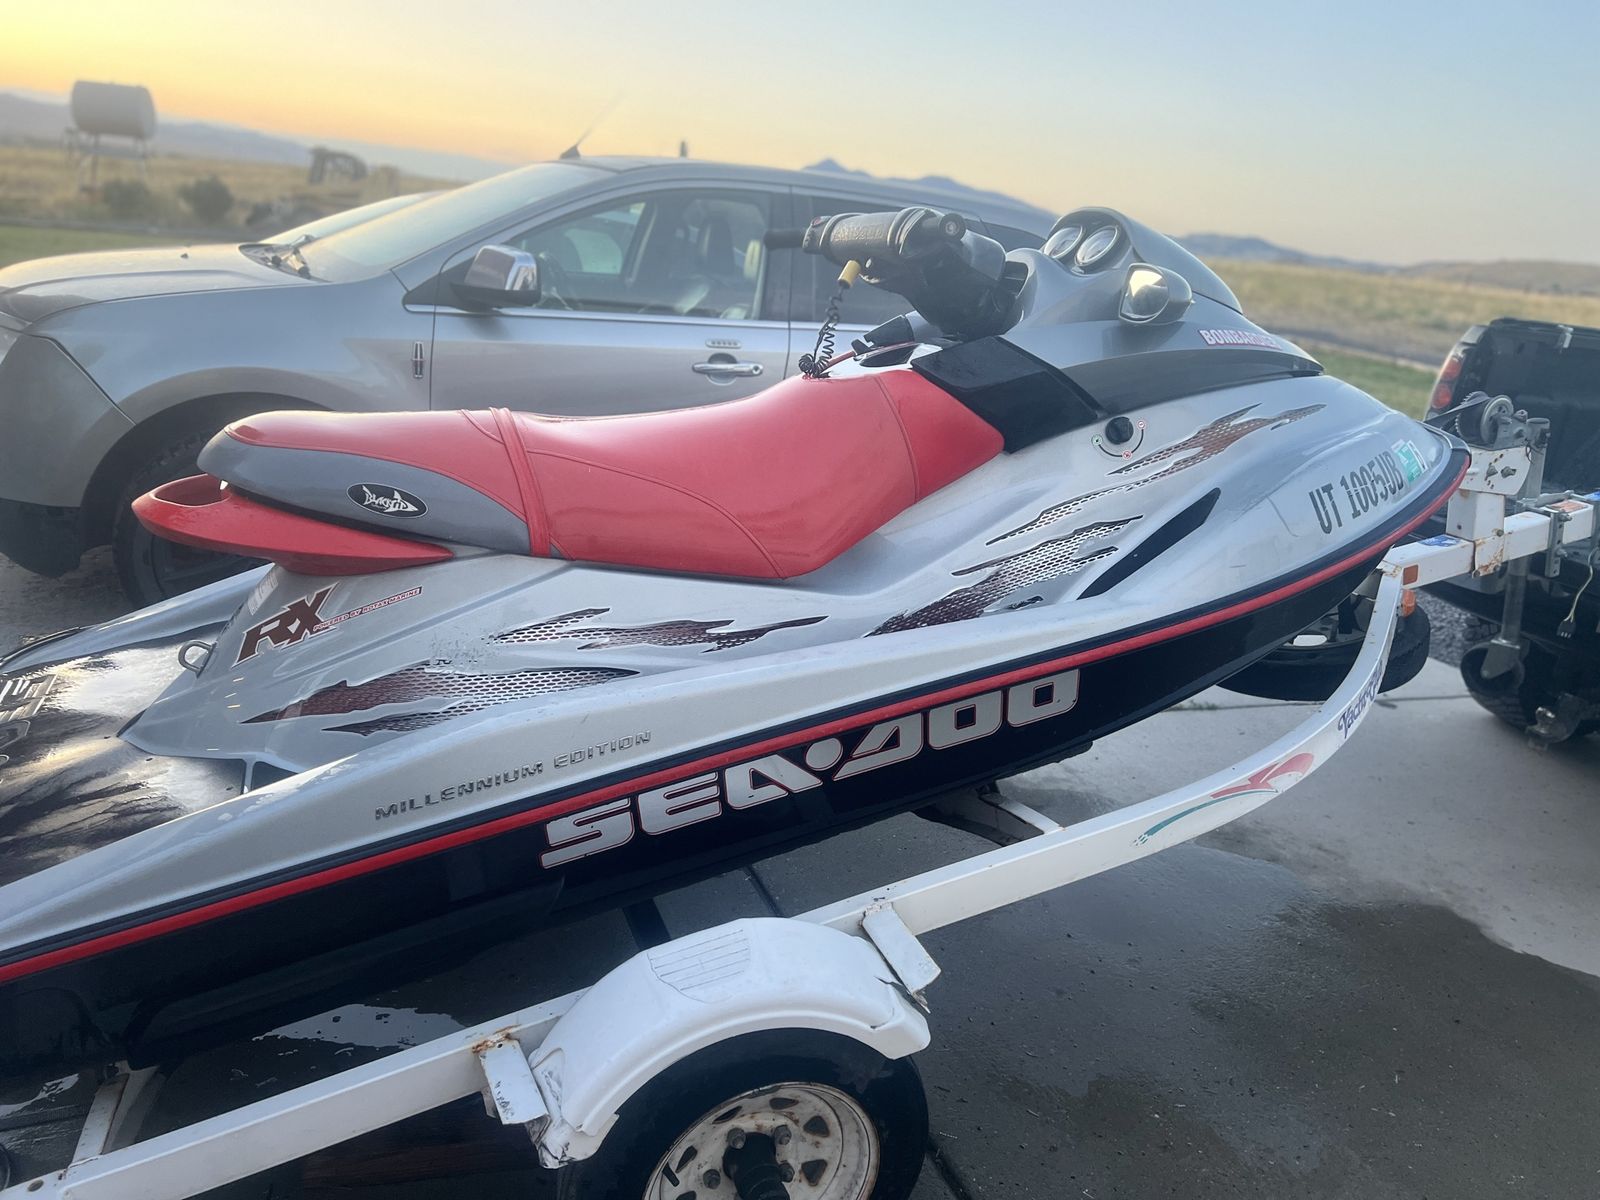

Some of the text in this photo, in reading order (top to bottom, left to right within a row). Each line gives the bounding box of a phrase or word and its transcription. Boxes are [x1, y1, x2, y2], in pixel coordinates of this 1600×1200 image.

[1309, 483, 1343, 534] UT
[1340, 450, 1404, 519] 1005UB
[231, 581, 340, 668] RX
[375, 730, 651, 820] MILLENNIUM EDITION
